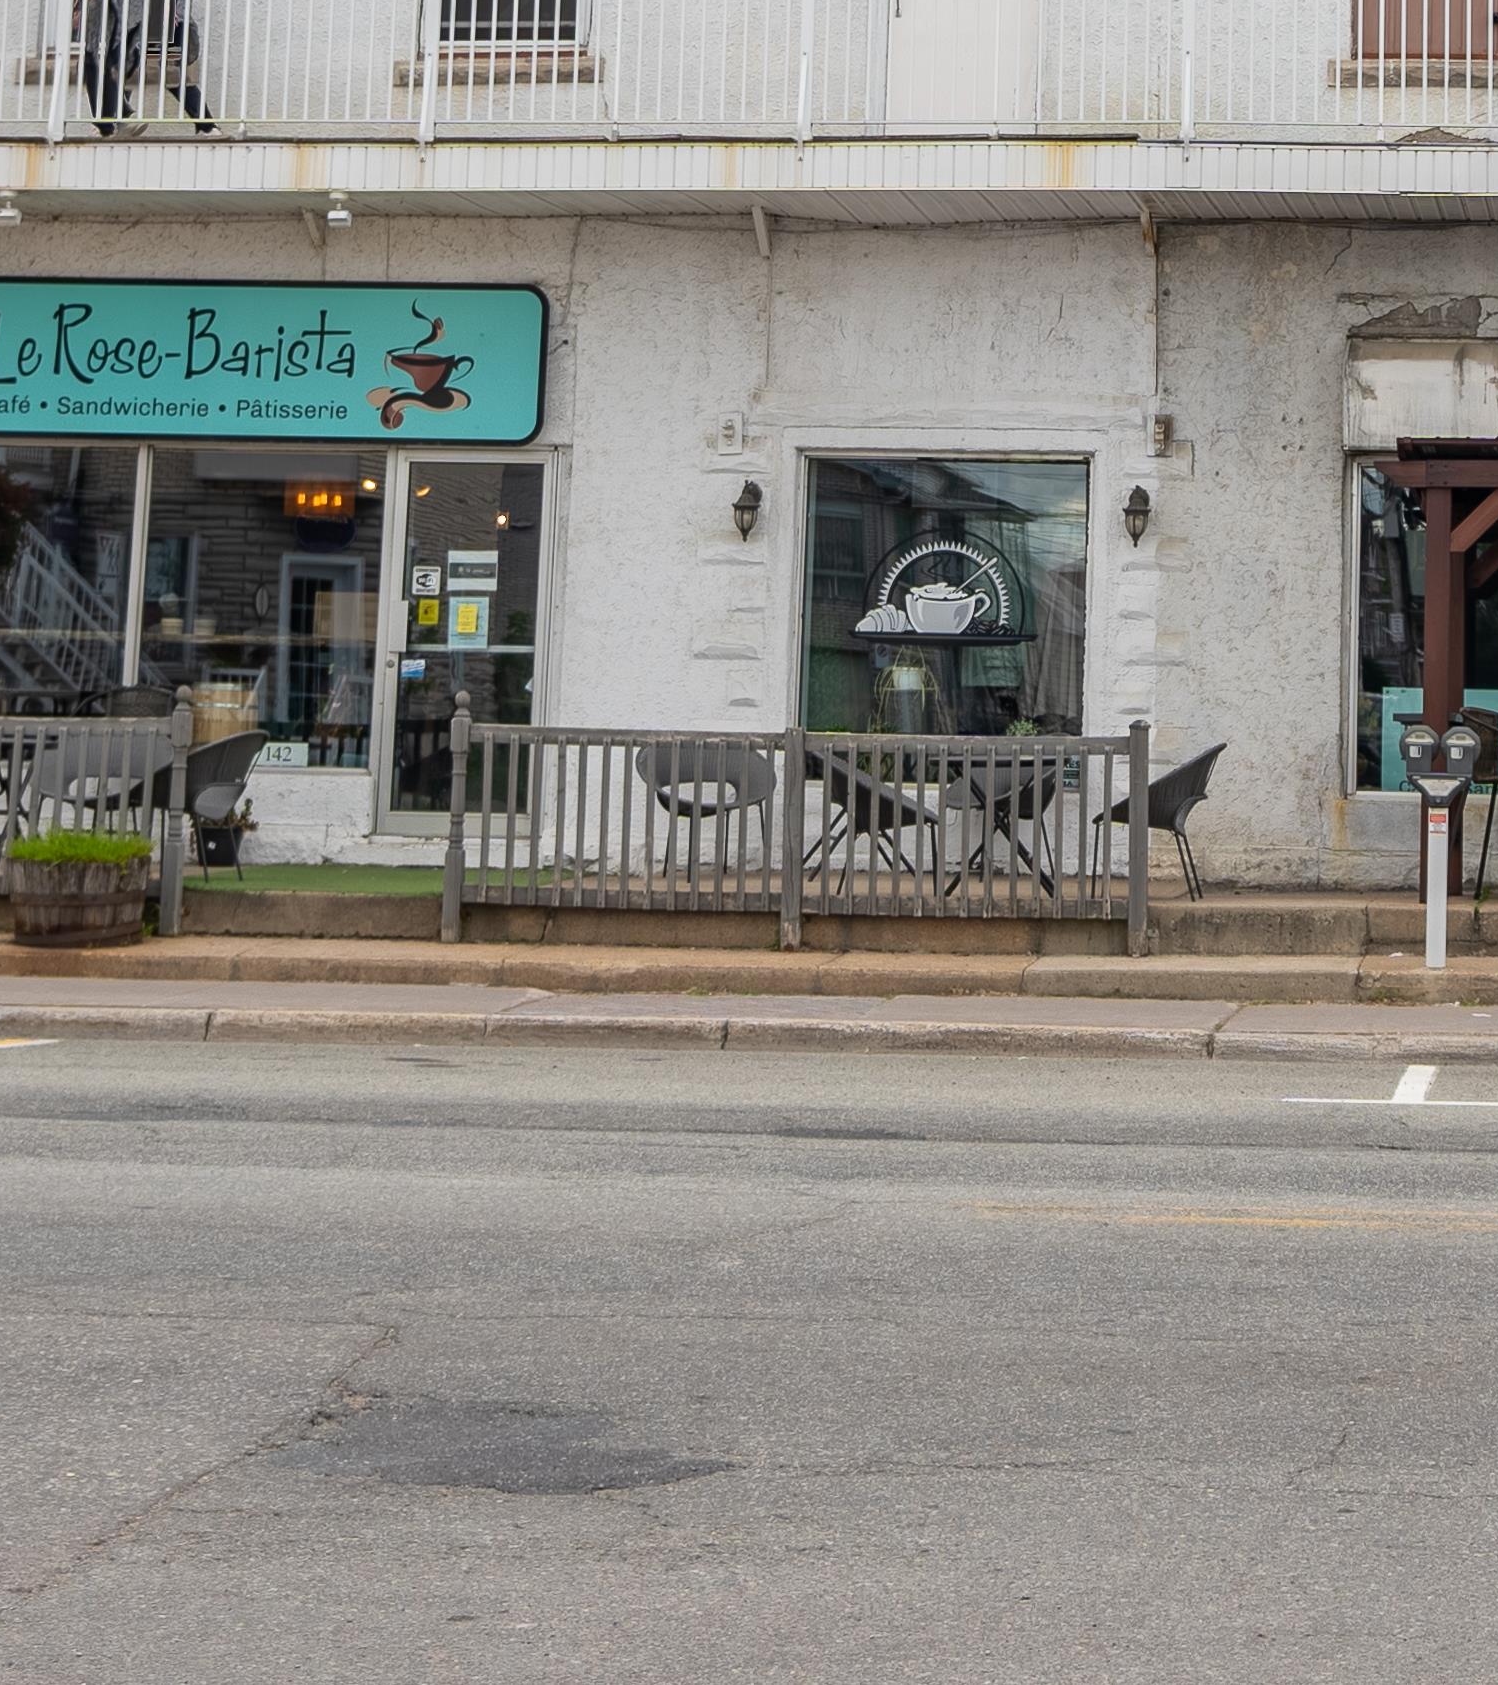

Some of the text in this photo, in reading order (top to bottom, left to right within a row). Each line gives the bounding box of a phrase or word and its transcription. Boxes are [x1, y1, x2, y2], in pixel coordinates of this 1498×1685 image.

[53, 302, 357, 385] Rose-Barista
[56, 395, 209, 418] Sandwicherie
[236, 398, 349, 421] Pâtisserie
[265, 745, 293, 763] 142
